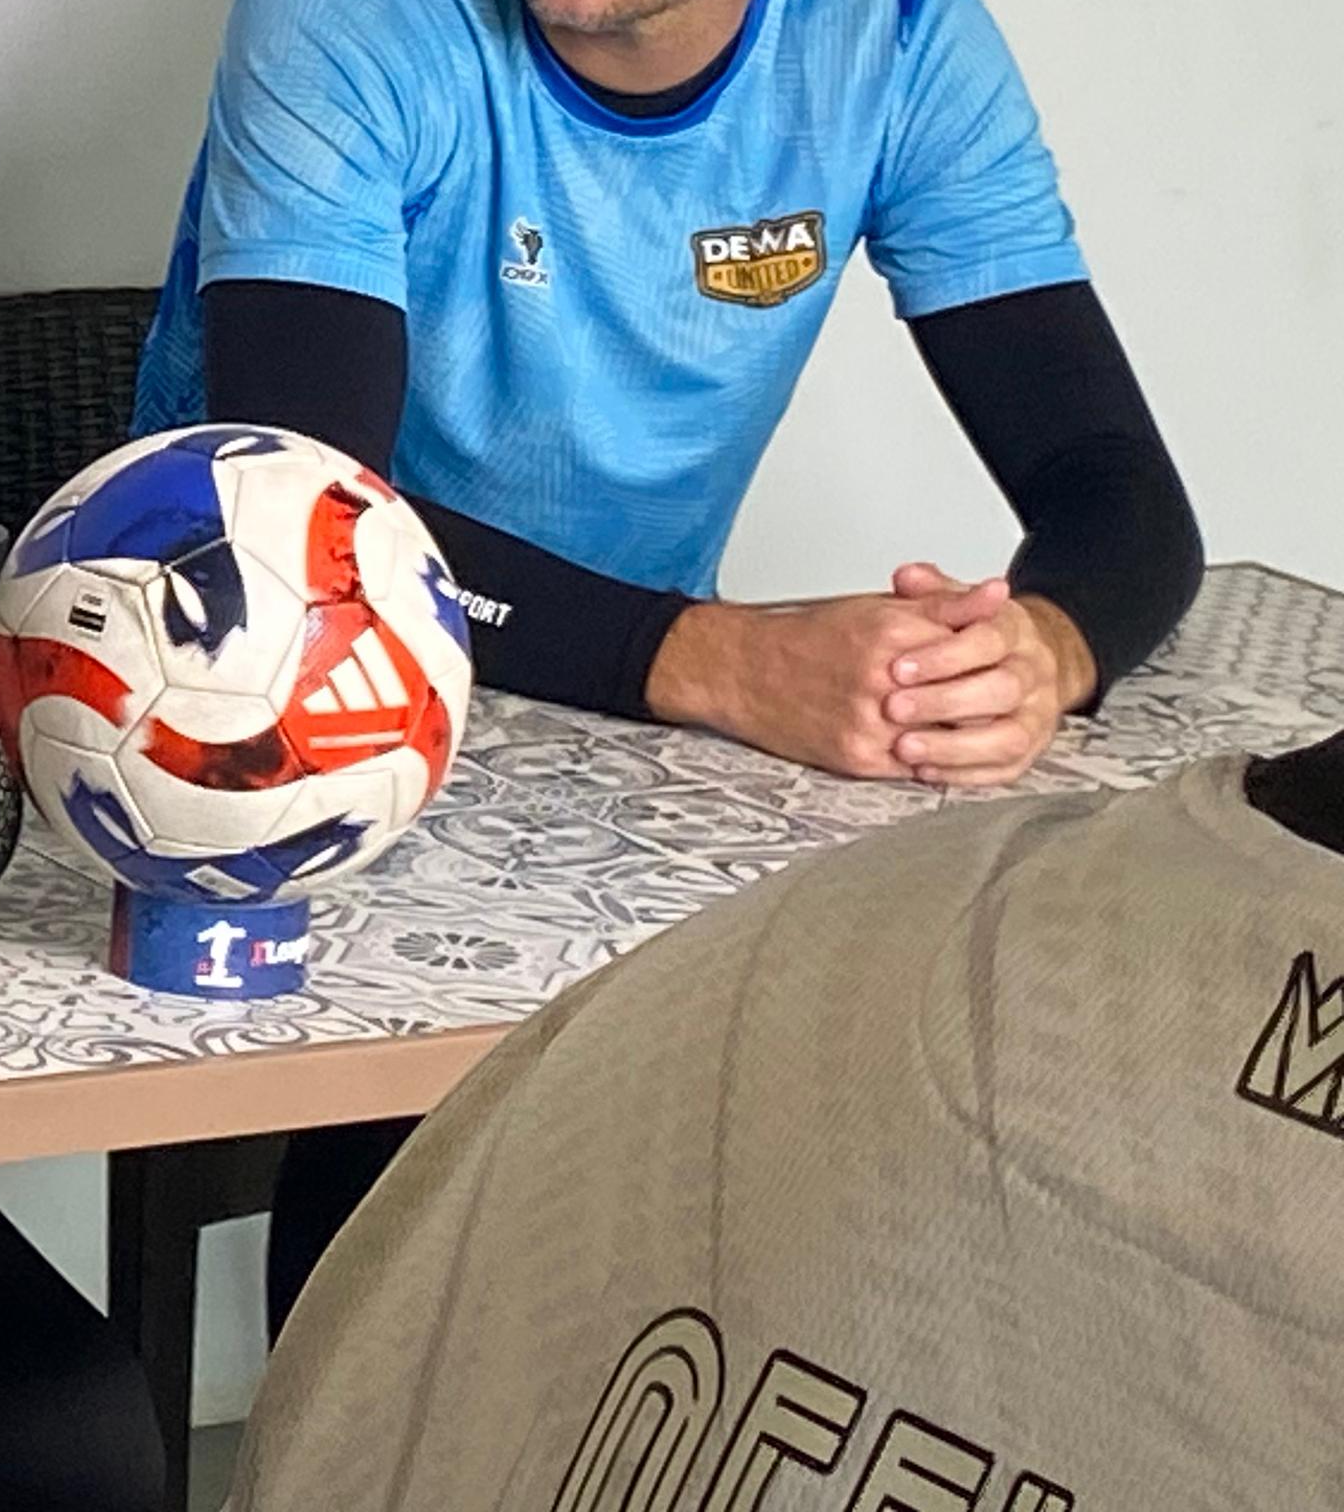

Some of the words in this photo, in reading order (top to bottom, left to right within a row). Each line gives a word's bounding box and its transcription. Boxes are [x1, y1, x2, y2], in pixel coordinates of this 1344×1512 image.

[701, 221, 815, 264] DEWA
[725, 259, 800, 290] UNITED
[457, 588, 513, 628] PORT
